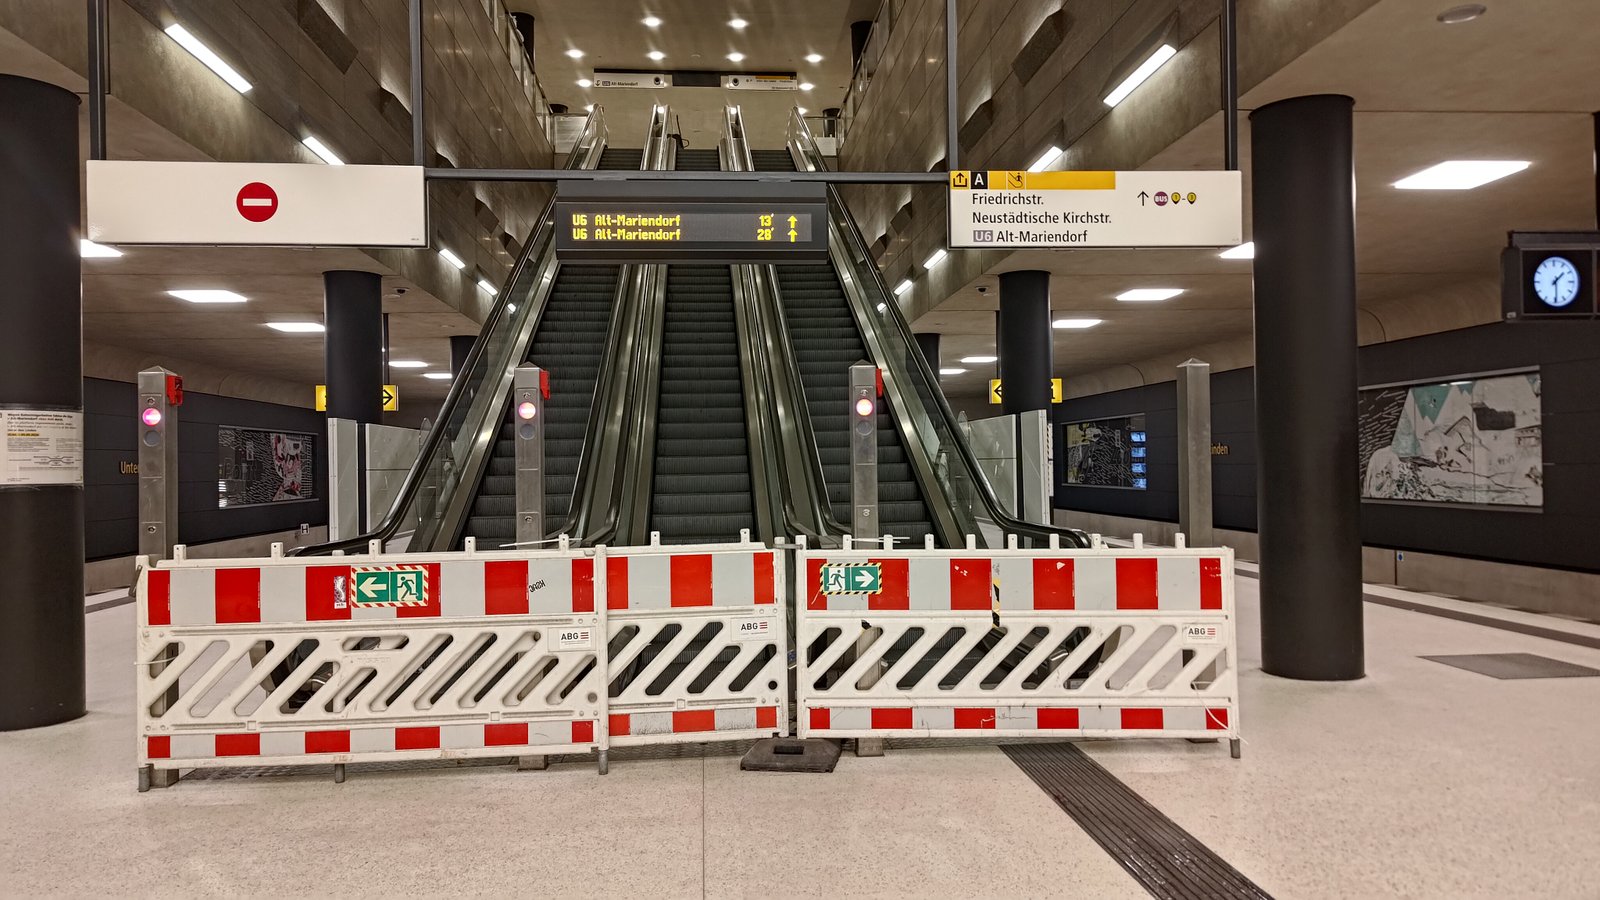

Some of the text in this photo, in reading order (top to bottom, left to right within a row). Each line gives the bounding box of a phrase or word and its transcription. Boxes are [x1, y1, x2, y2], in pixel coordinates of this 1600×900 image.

[974, 173, 985, 186] A
[972, 193, 1044, 205] Friedrichstr.
[1154, 195, 1168, 203] BUS
[572, 214, 588, 226] U6
[594, 214, 681, 226] Alt-Mariendorf
[972, 211, 1112, 223] Neustädtische Kirchstr.
[572, 228, 588, 240] U6
[594, 228, 681, 240] Alt-Mariendorf
[974, 230, 1088, 242] U6 Alt-Mariendorf
[120, 461, 139, 474] Unte
[741, 622, 758, 630] ABG
[1188, 627, 1206, 635] ABG
[561, 632, 579, 640] ABG
